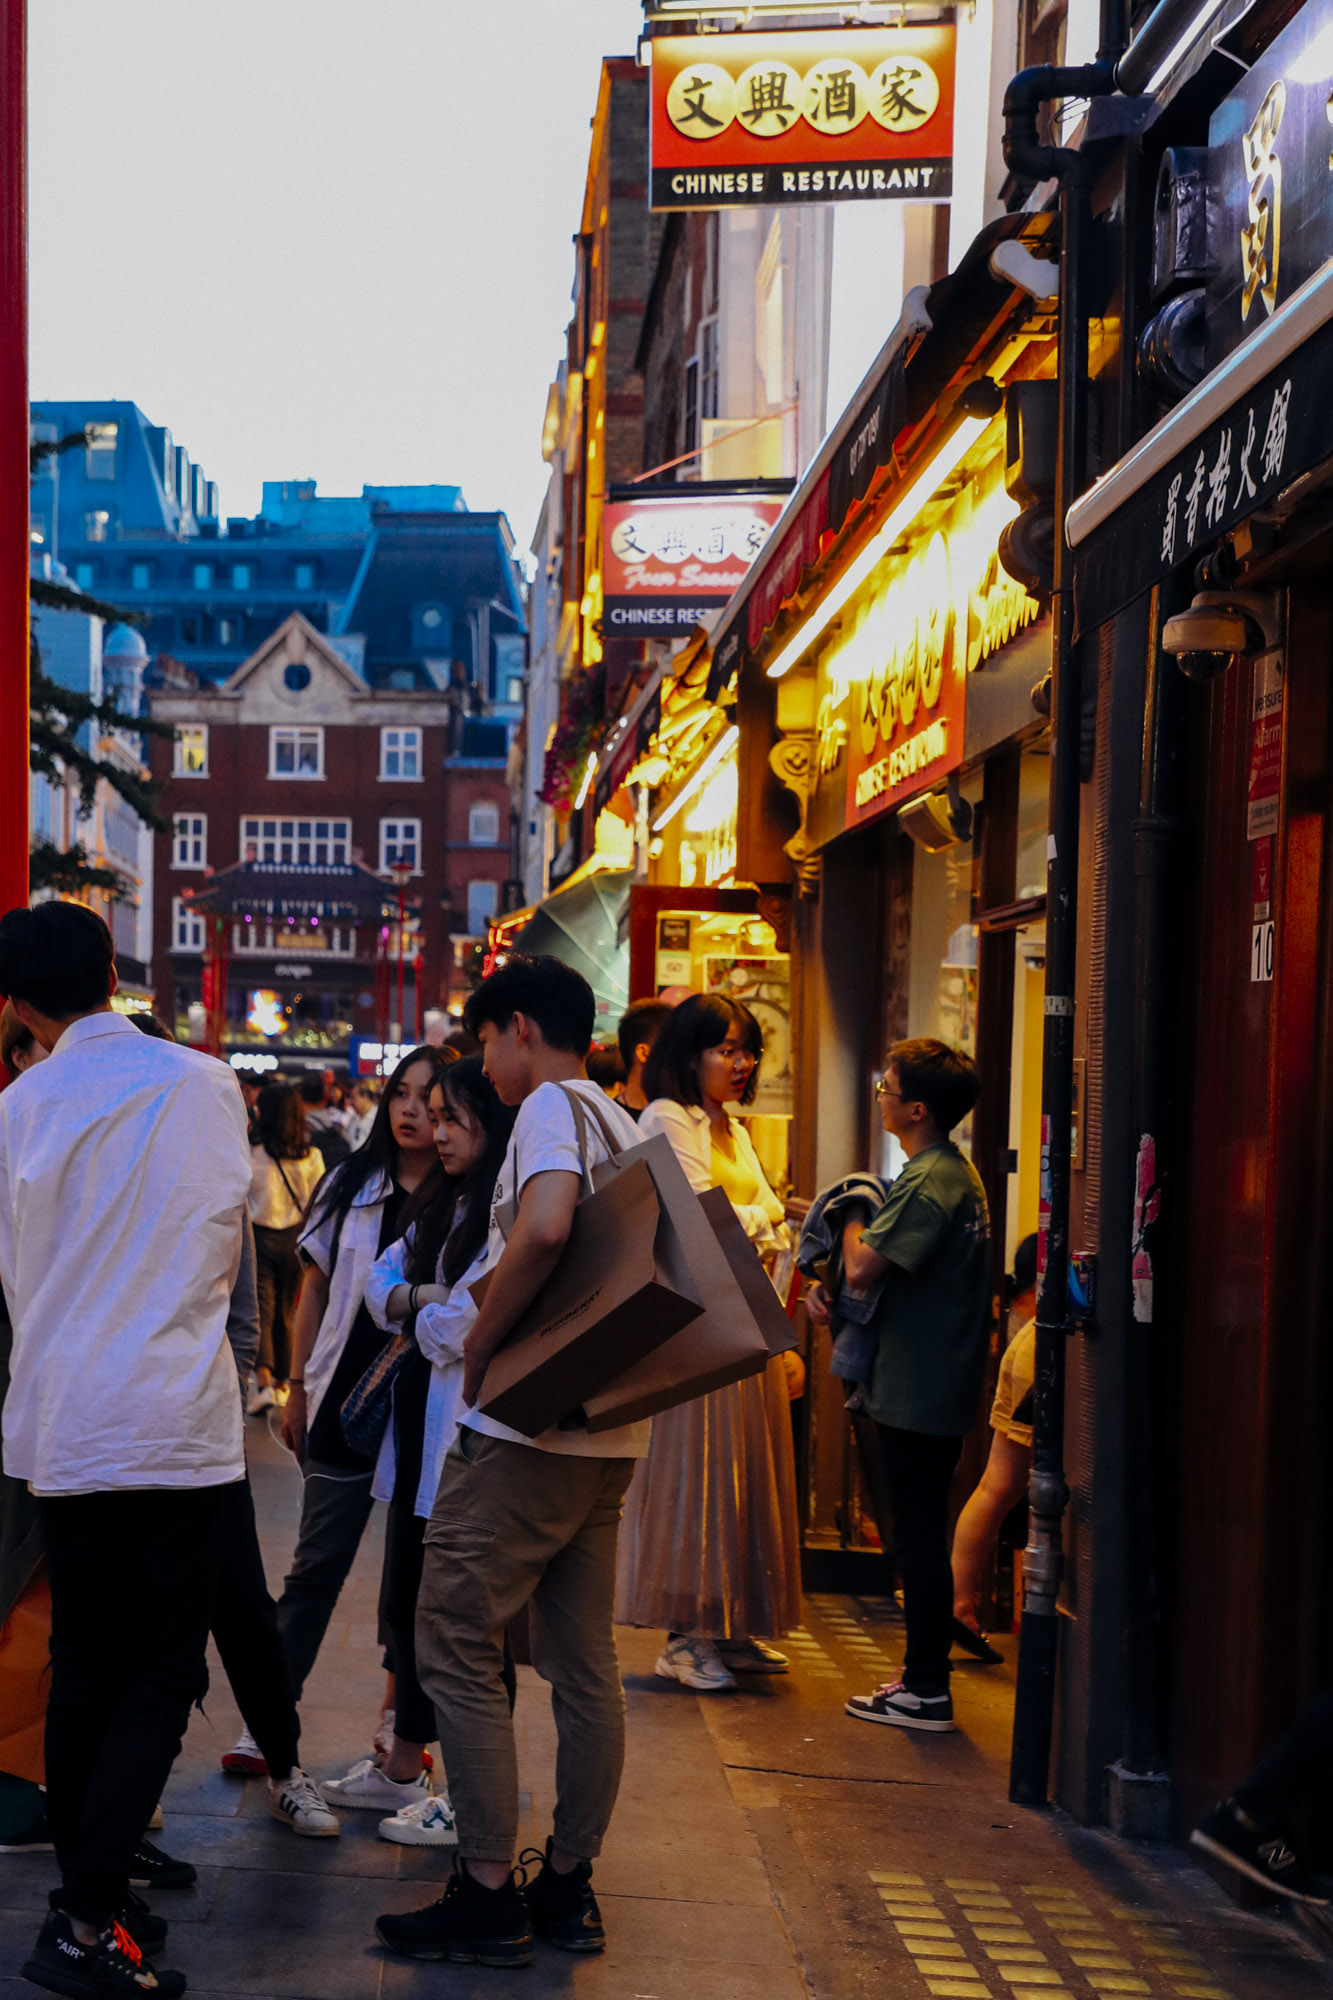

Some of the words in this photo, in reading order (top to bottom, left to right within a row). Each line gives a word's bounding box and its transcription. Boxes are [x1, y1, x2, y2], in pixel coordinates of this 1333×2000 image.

[676, 66, 927, 128] 文興酒家
[671, 173, 764, 194] CHINESE
[782, 167, 934, 191] RESTAURANT
[610, 608, 674, 624] CHINESE
[1254, 923, 1275, 980] 10
